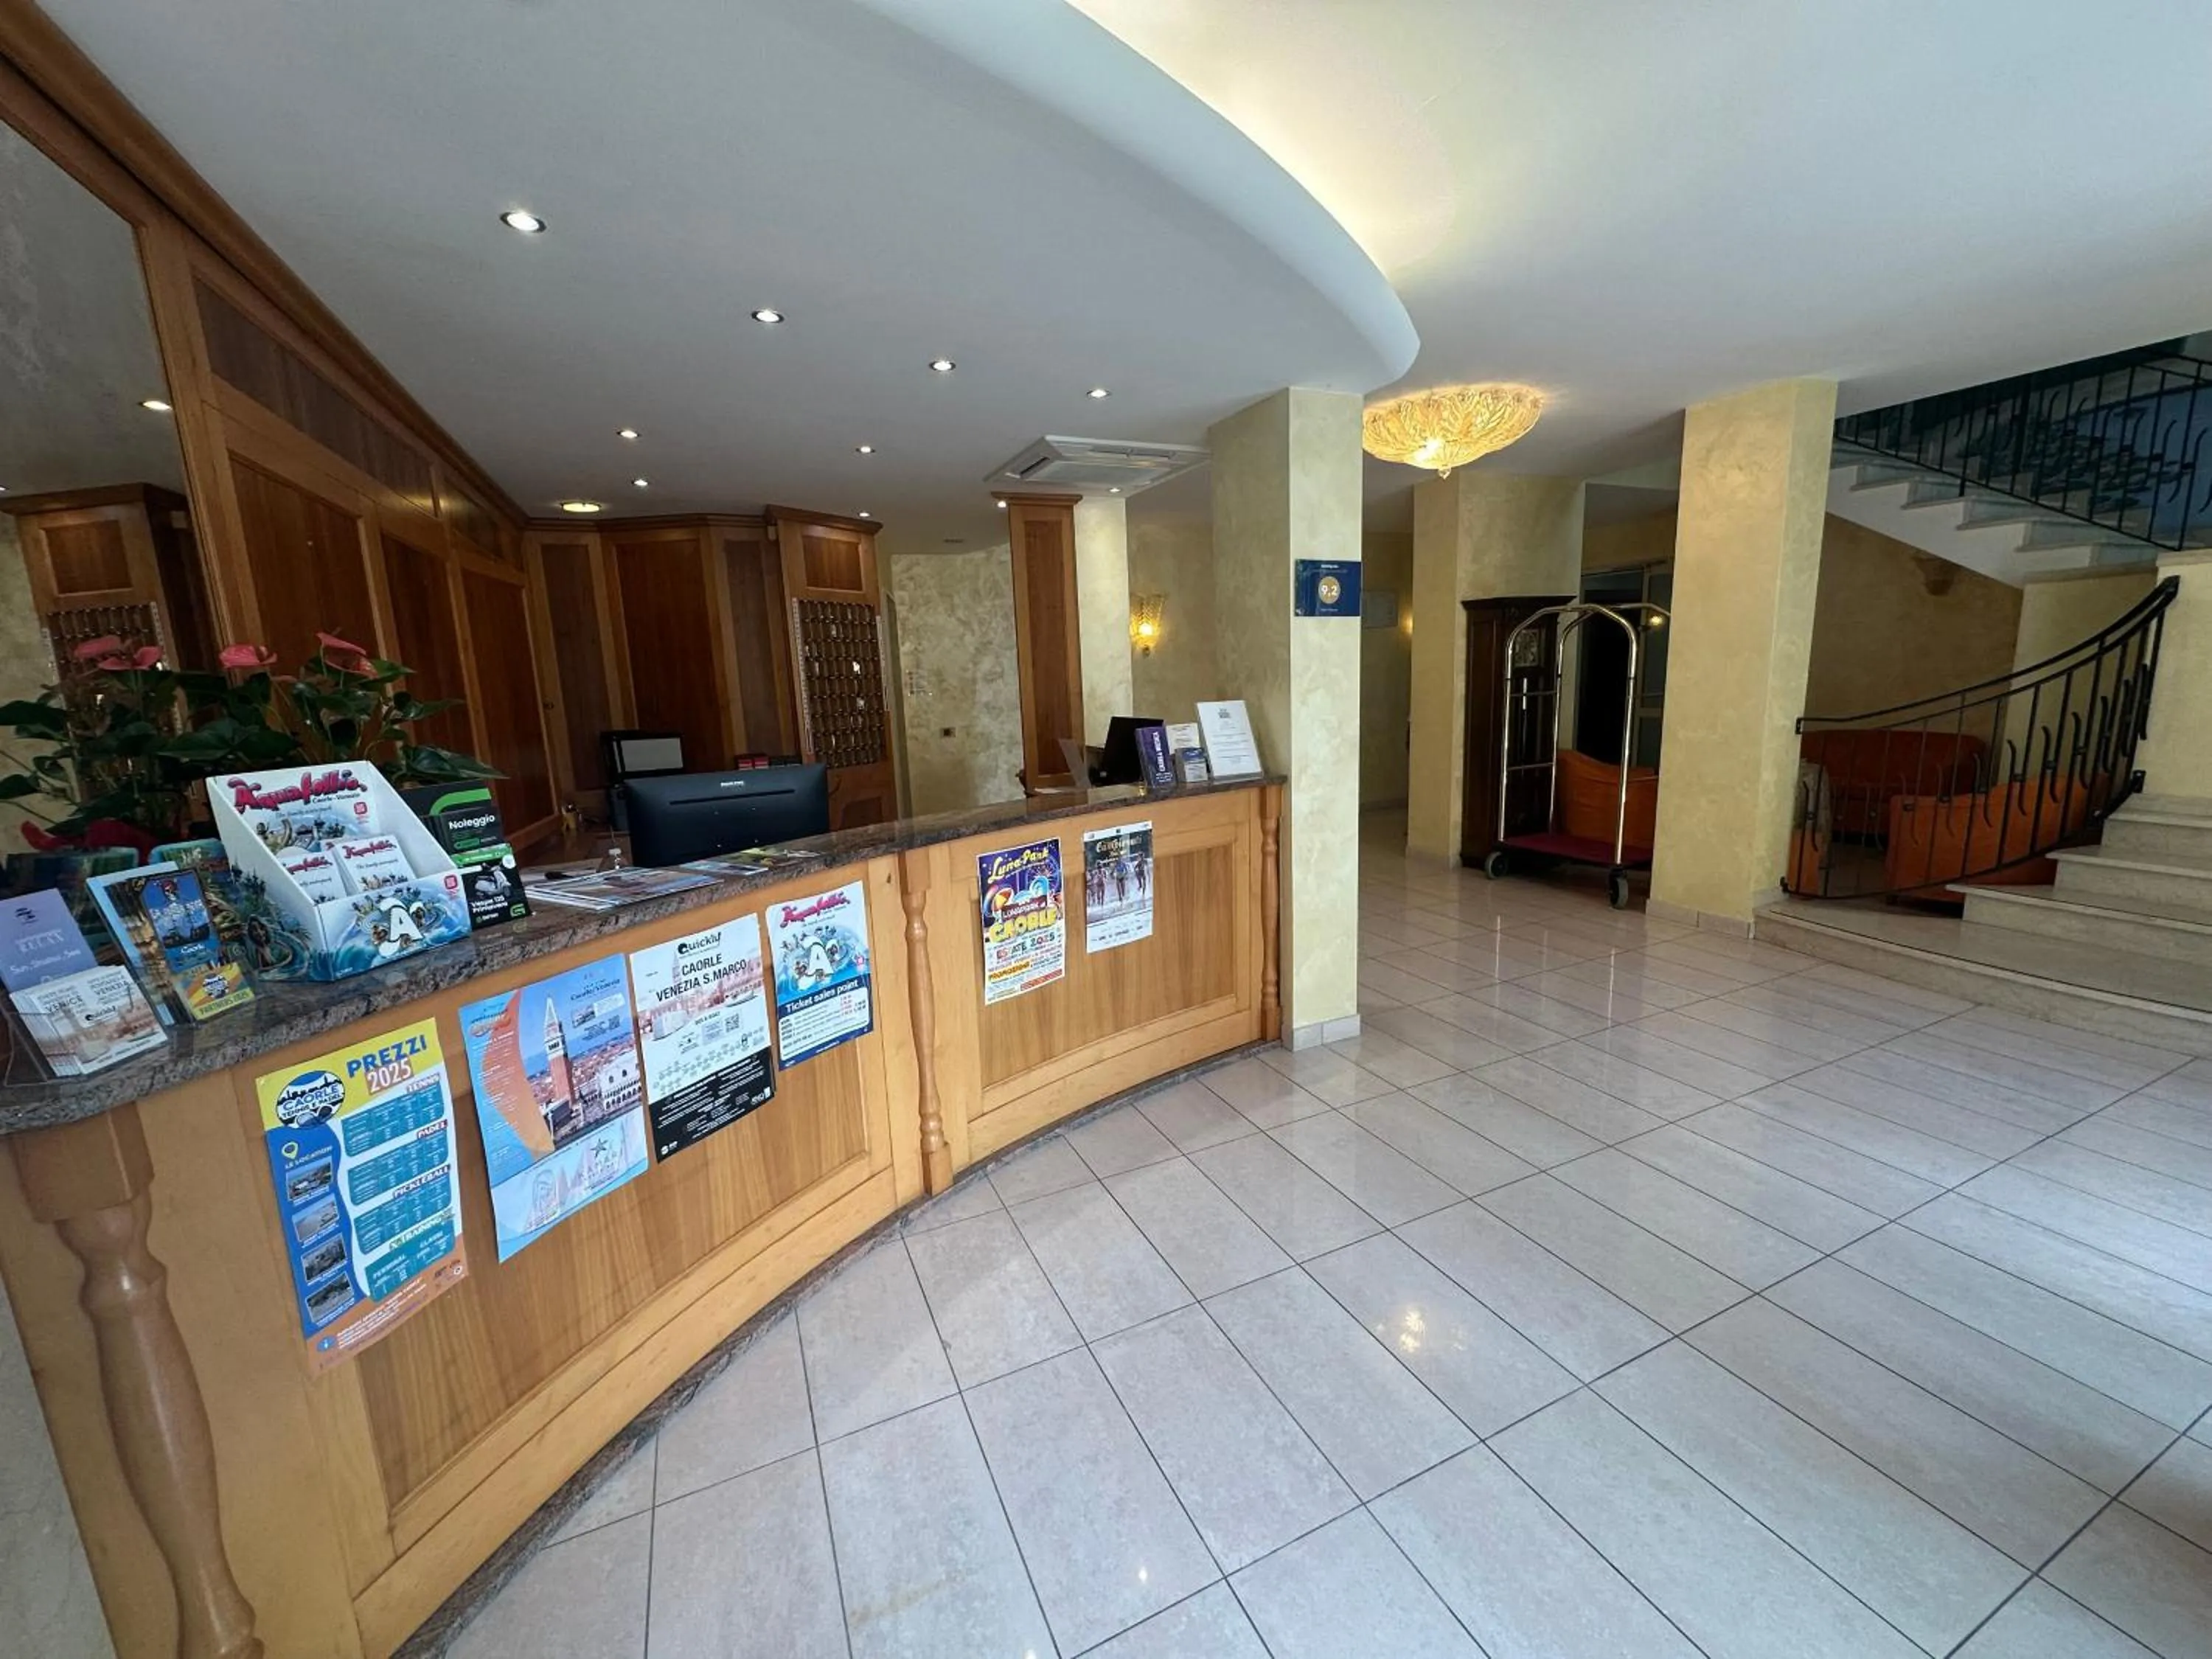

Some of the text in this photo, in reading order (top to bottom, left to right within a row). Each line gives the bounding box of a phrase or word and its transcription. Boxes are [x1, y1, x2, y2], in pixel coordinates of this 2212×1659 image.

[448, 814, 495, 830] Noleggio
[989, 908, 1057, 944] CAORLE
[678, 931, 722, 954] Quickly
[681, 953, 723, 977] CAORLE
[655, 959, 747, 1002] VENEZIA S.MARCO
[785, 980, 859, 1014] Ticket sales point
[346, 1034, 428, 1079] PREZZI
[367, 1057, 411, 1093] 2025
[282, 1085, 339, 1111] CAORLE
[282, 1104, 310, 1118] TENNIS
[418, 1121, 448, 1138] PADEL
[295, 1146, 333, 1165] LOCATION
[394, 1166, 449, 1197] PICKLEBALL
